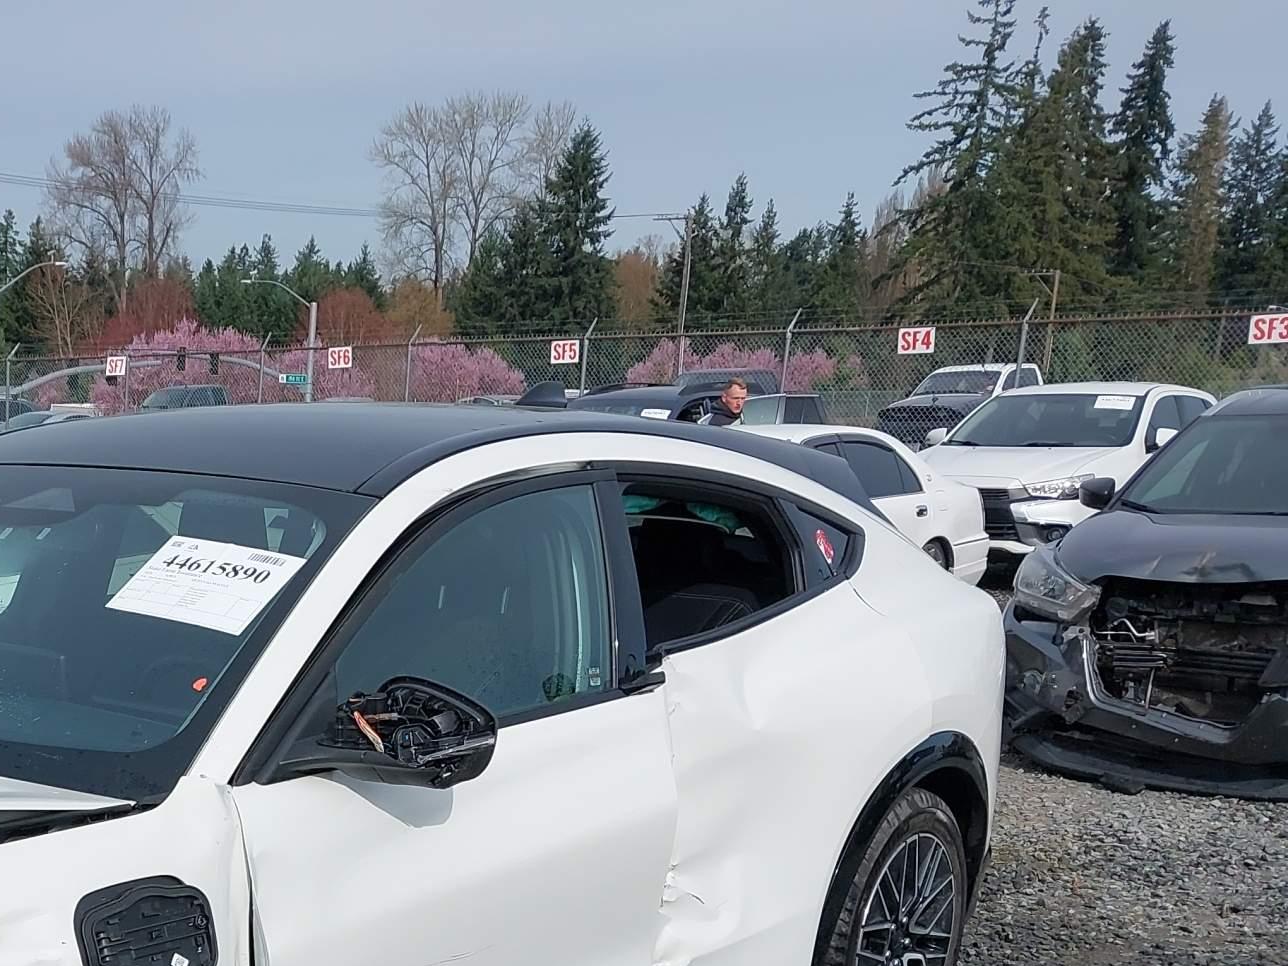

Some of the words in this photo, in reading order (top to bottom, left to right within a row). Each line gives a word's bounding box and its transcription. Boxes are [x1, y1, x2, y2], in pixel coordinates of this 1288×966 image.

[1253, 316, 1288, 340] SF3
[901, 330, 932, 351] SF4
[330, 349, 350, 366] SF6
[553, 342, 577, 361] SF5
[108, 358, 125, 374] SF7
[162, 554, 271, 584] 44615890
